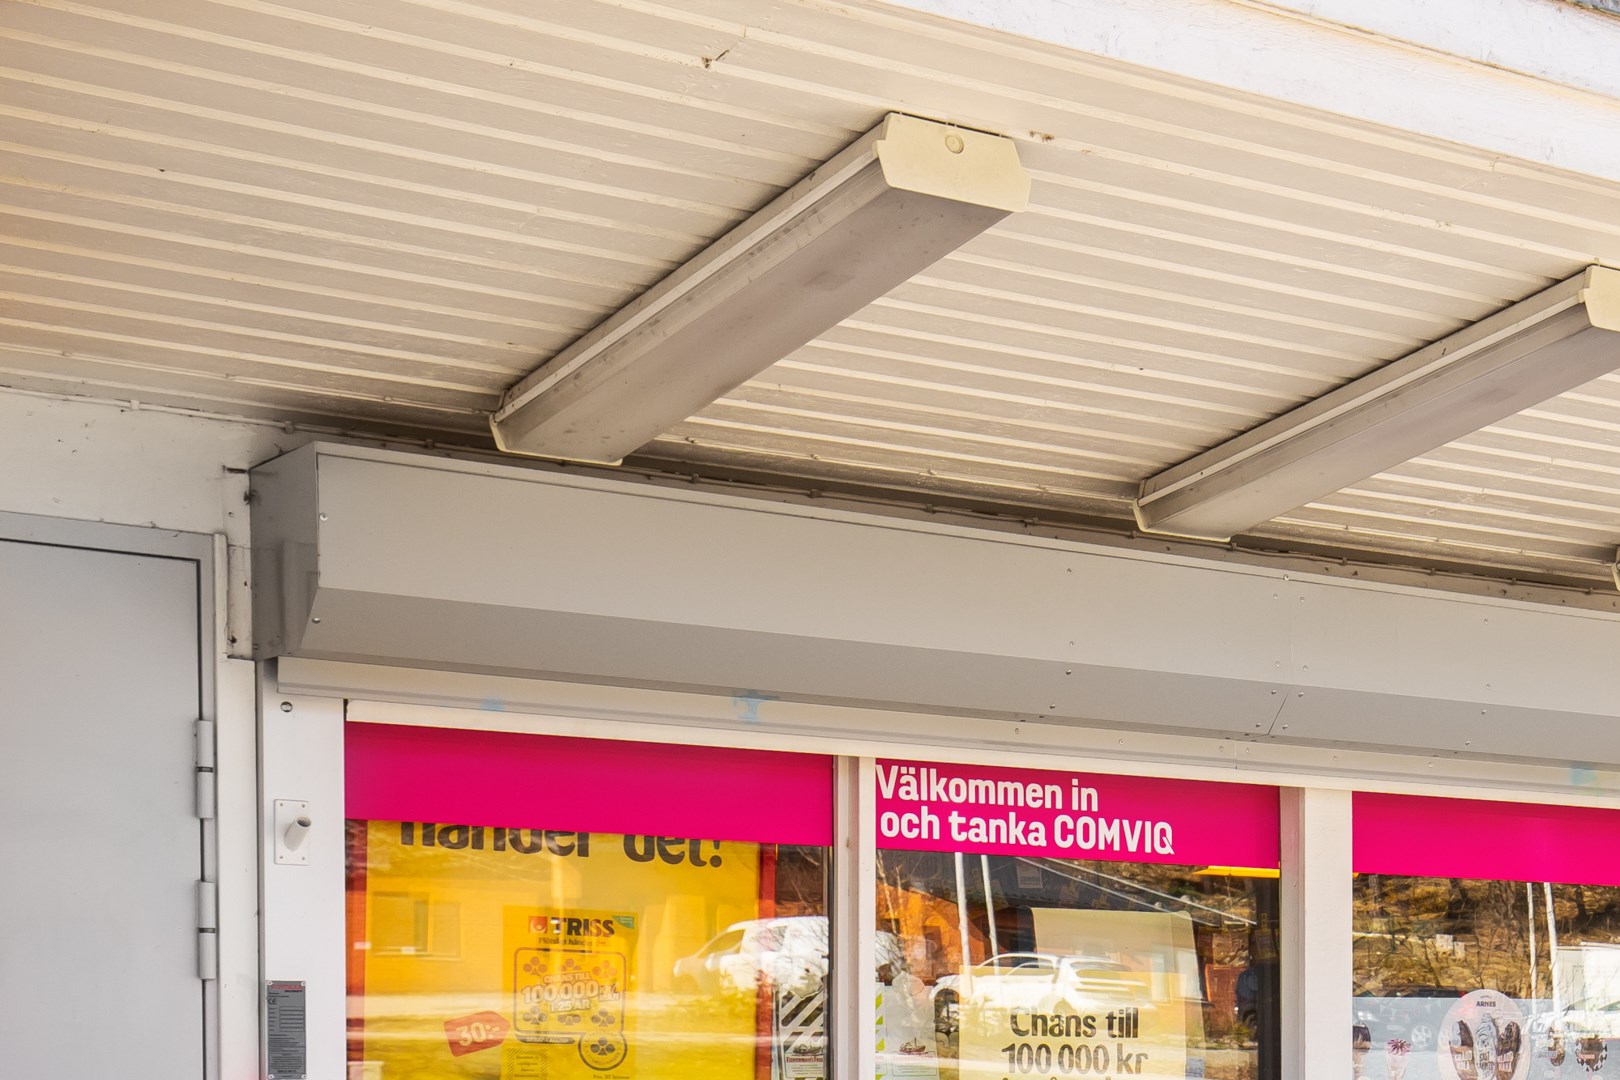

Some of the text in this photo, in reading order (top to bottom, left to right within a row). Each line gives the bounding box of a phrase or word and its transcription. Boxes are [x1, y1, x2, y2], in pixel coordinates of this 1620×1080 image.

[876, 765, 1099, 812] Välkommen in
[880, 807, 1174, 856] och tanka COMVIQ
[551, 916, 615, 938] TRISS
[456, 1021, 500, 1047] 30:-
[1010, 1007, 1139, 1038] Chans till
[1002, 1043, 1149, 1075] 100 000 kr
